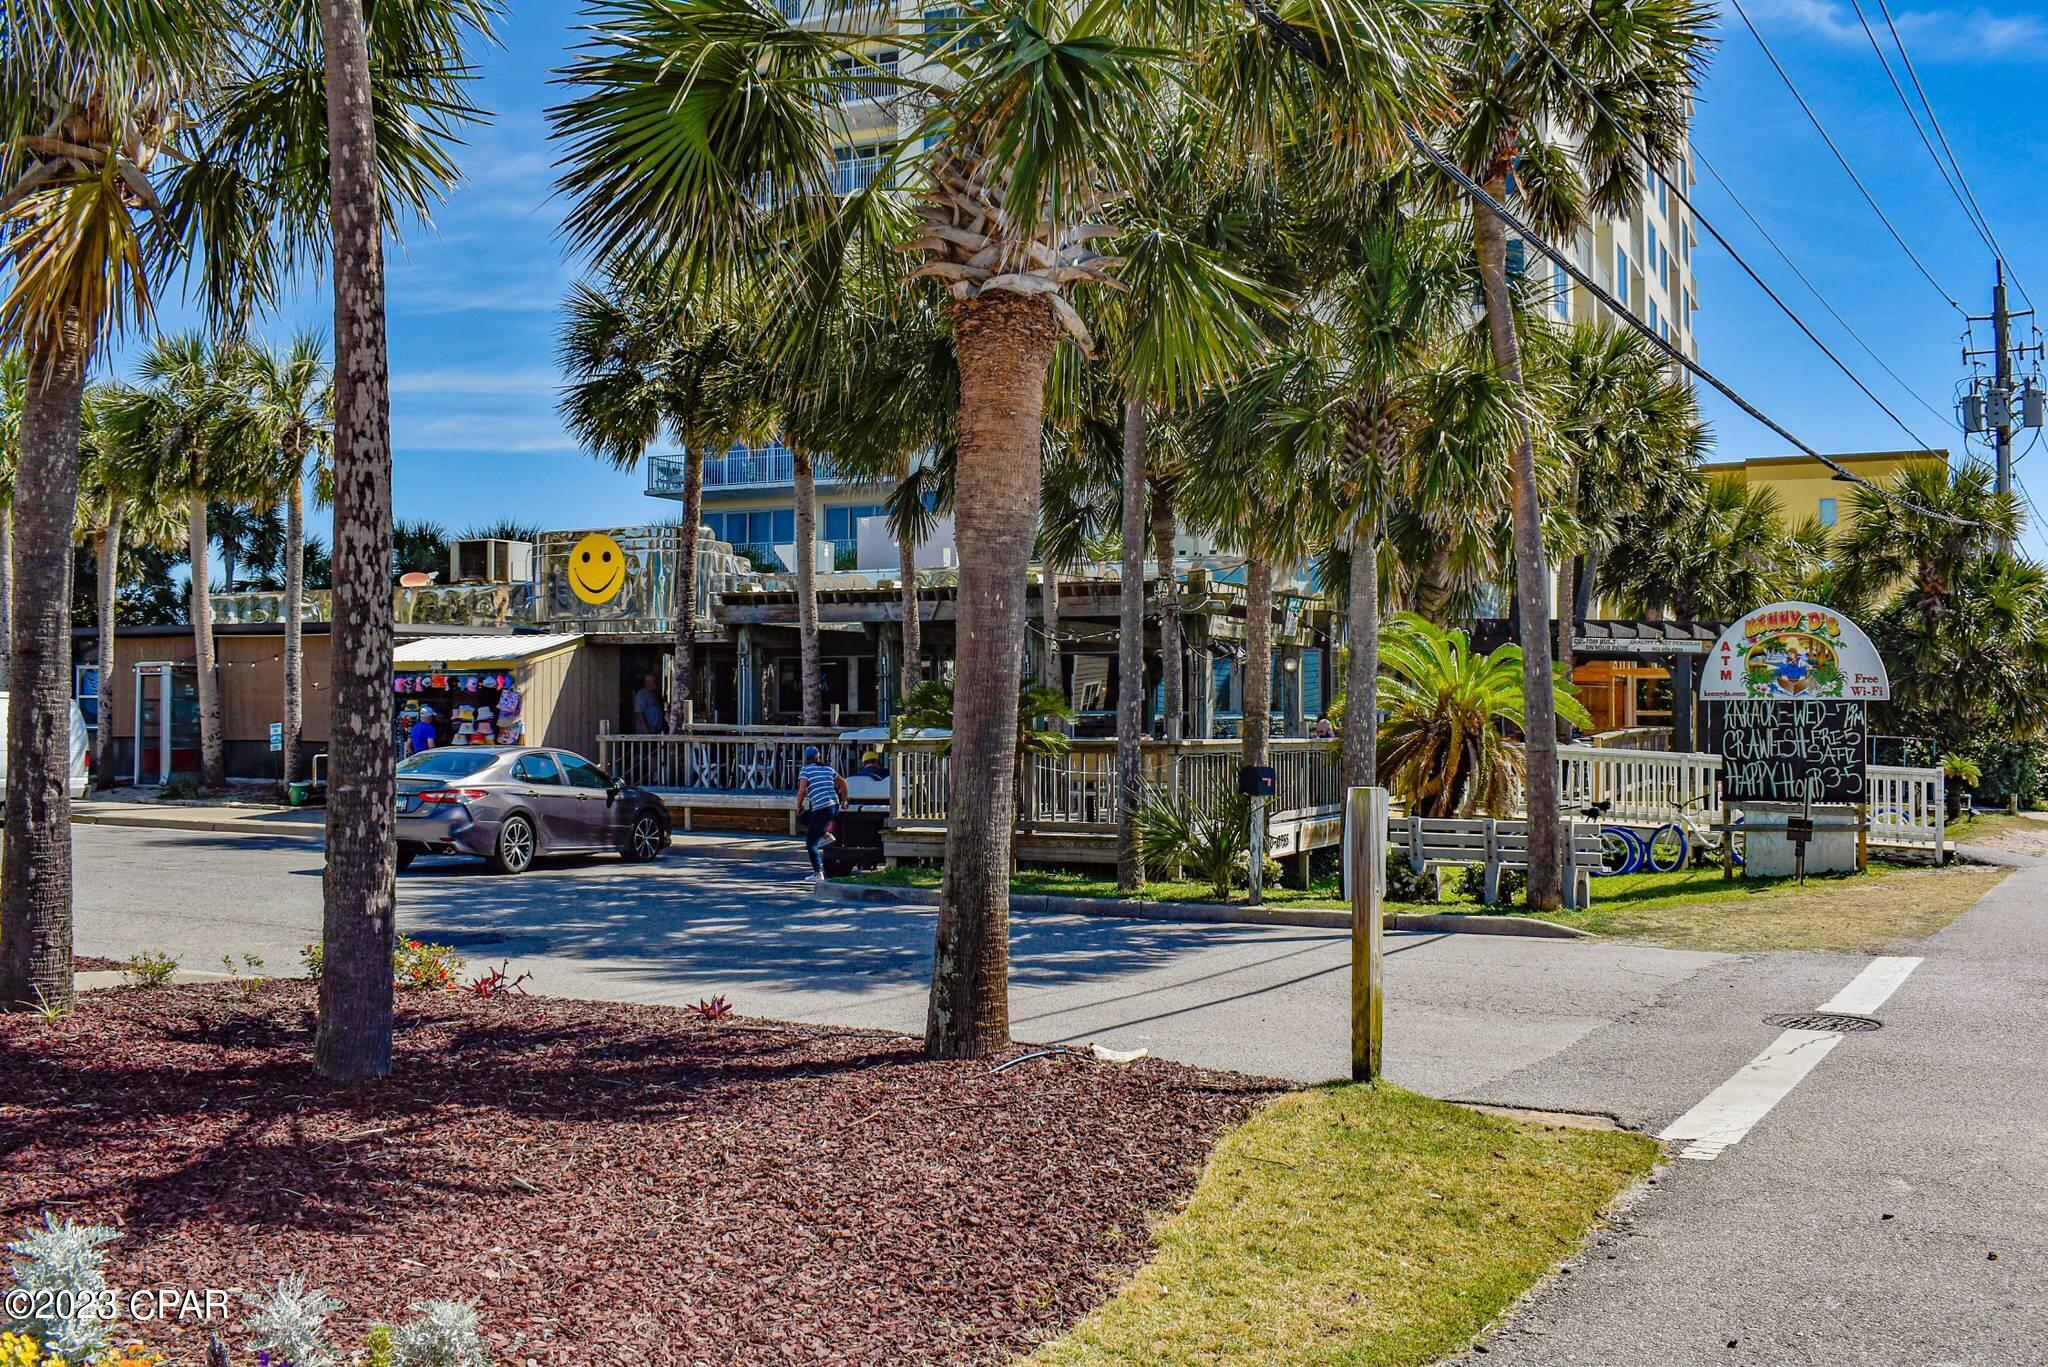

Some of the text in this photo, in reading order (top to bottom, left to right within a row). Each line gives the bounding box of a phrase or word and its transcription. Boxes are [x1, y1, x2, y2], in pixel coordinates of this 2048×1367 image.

[1744, 610, 1841, 638] KENNY D'S
[1854, 673, 1879, 684] Free
[1850, 687, 1884, 697] Wi-Fi
[1725, 760, 1779, 798] HAPPY
